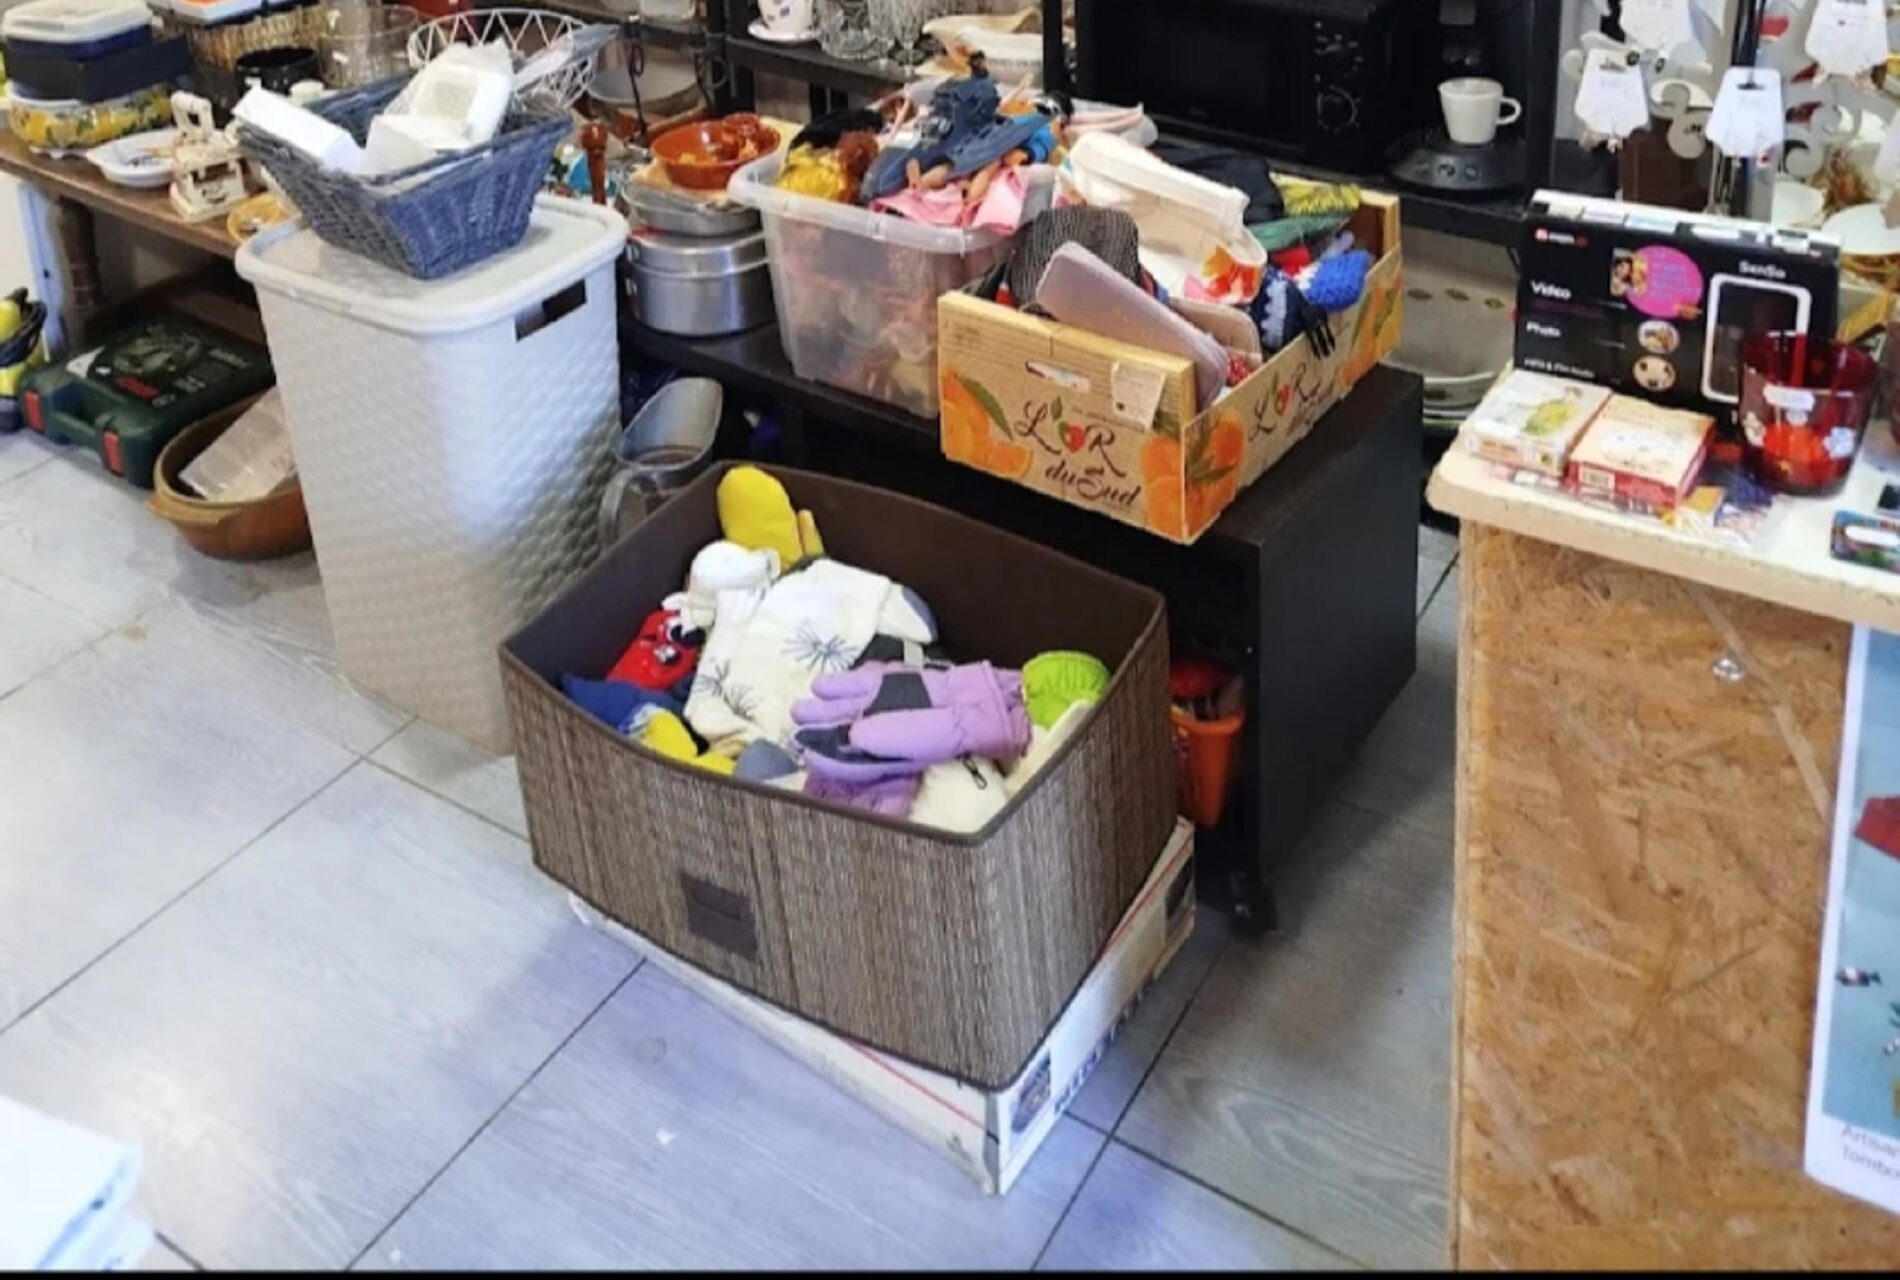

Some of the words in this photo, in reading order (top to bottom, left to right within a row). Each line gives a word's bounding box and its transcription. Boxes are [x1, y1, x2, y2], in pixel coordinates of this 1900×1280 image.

[1530, 279, 1572, 300] Video
[1526, 321, 1562, 338] Photo
[1045, 460, 1077, 485] du
[1076, 467, 1142, 507] Sud
